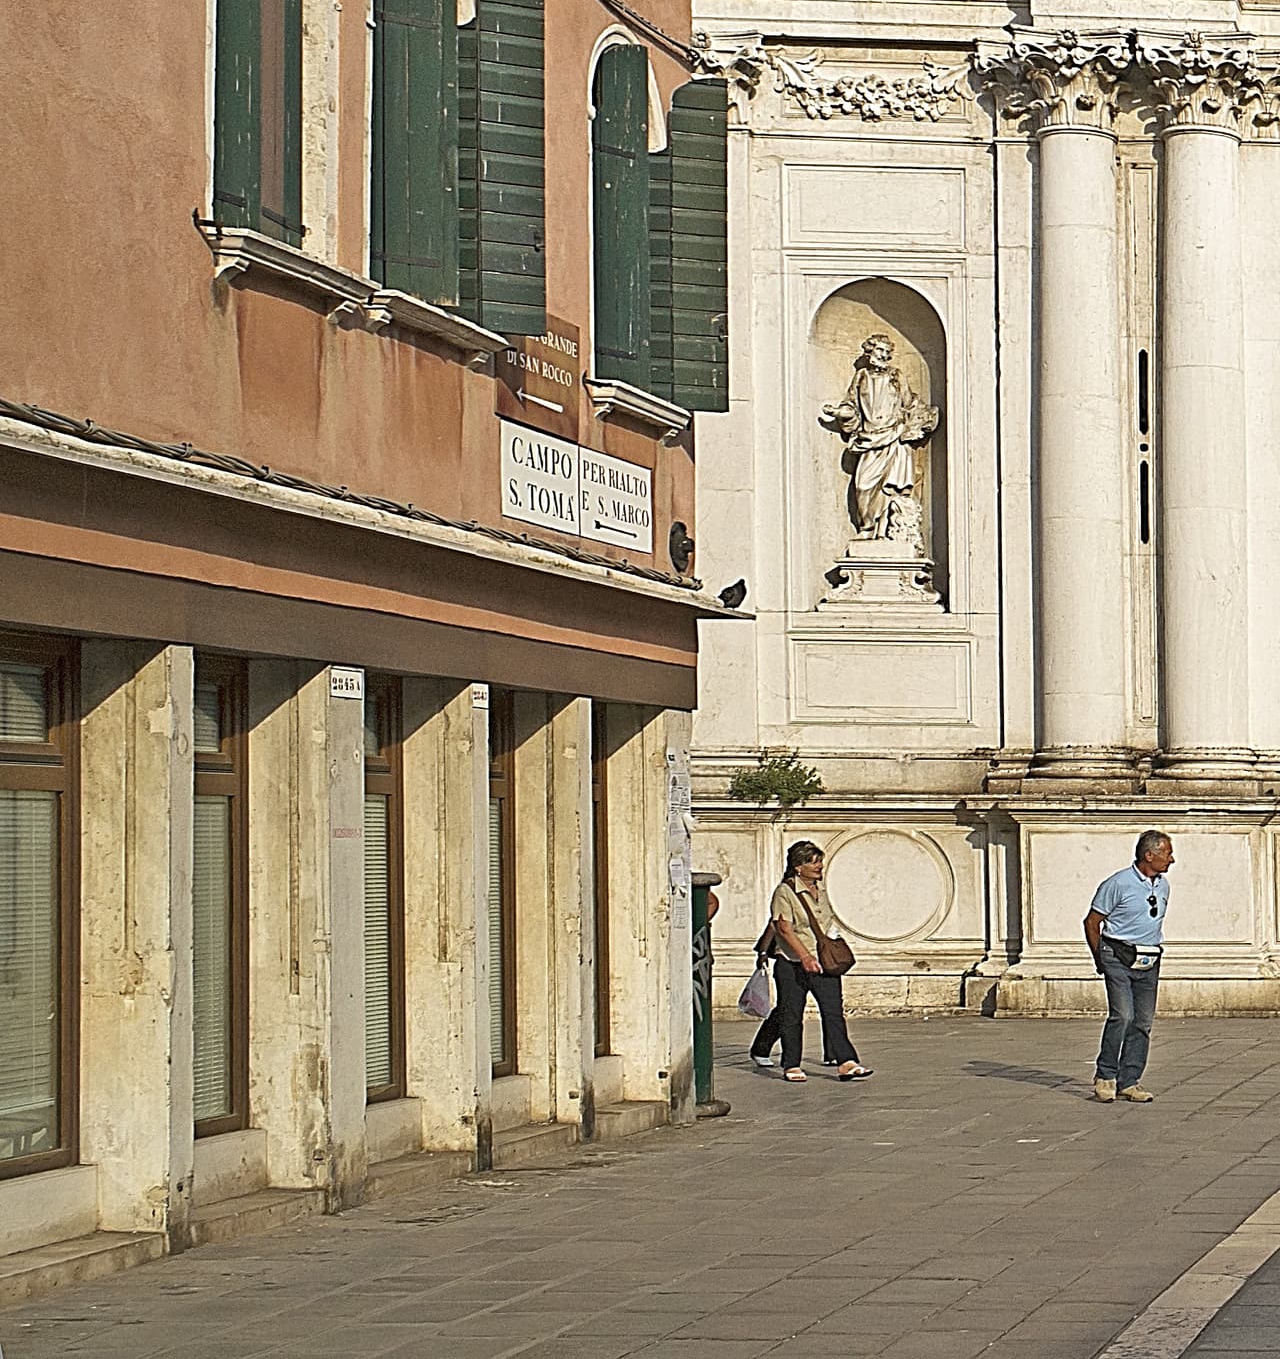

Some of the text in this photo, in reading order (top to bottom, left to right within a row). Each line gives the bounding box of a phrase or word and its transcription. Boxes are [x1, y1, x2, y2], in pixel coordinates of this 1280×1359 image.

[507, 350, 573, 387] DI SAN ROCCO
[511, 437, 573, 480] CAMPO
[509, 479, 522, 508] S.
[582, 460, 648, 498] PER RIALTO
[582, 490, 650, 528] E S. MARCO
